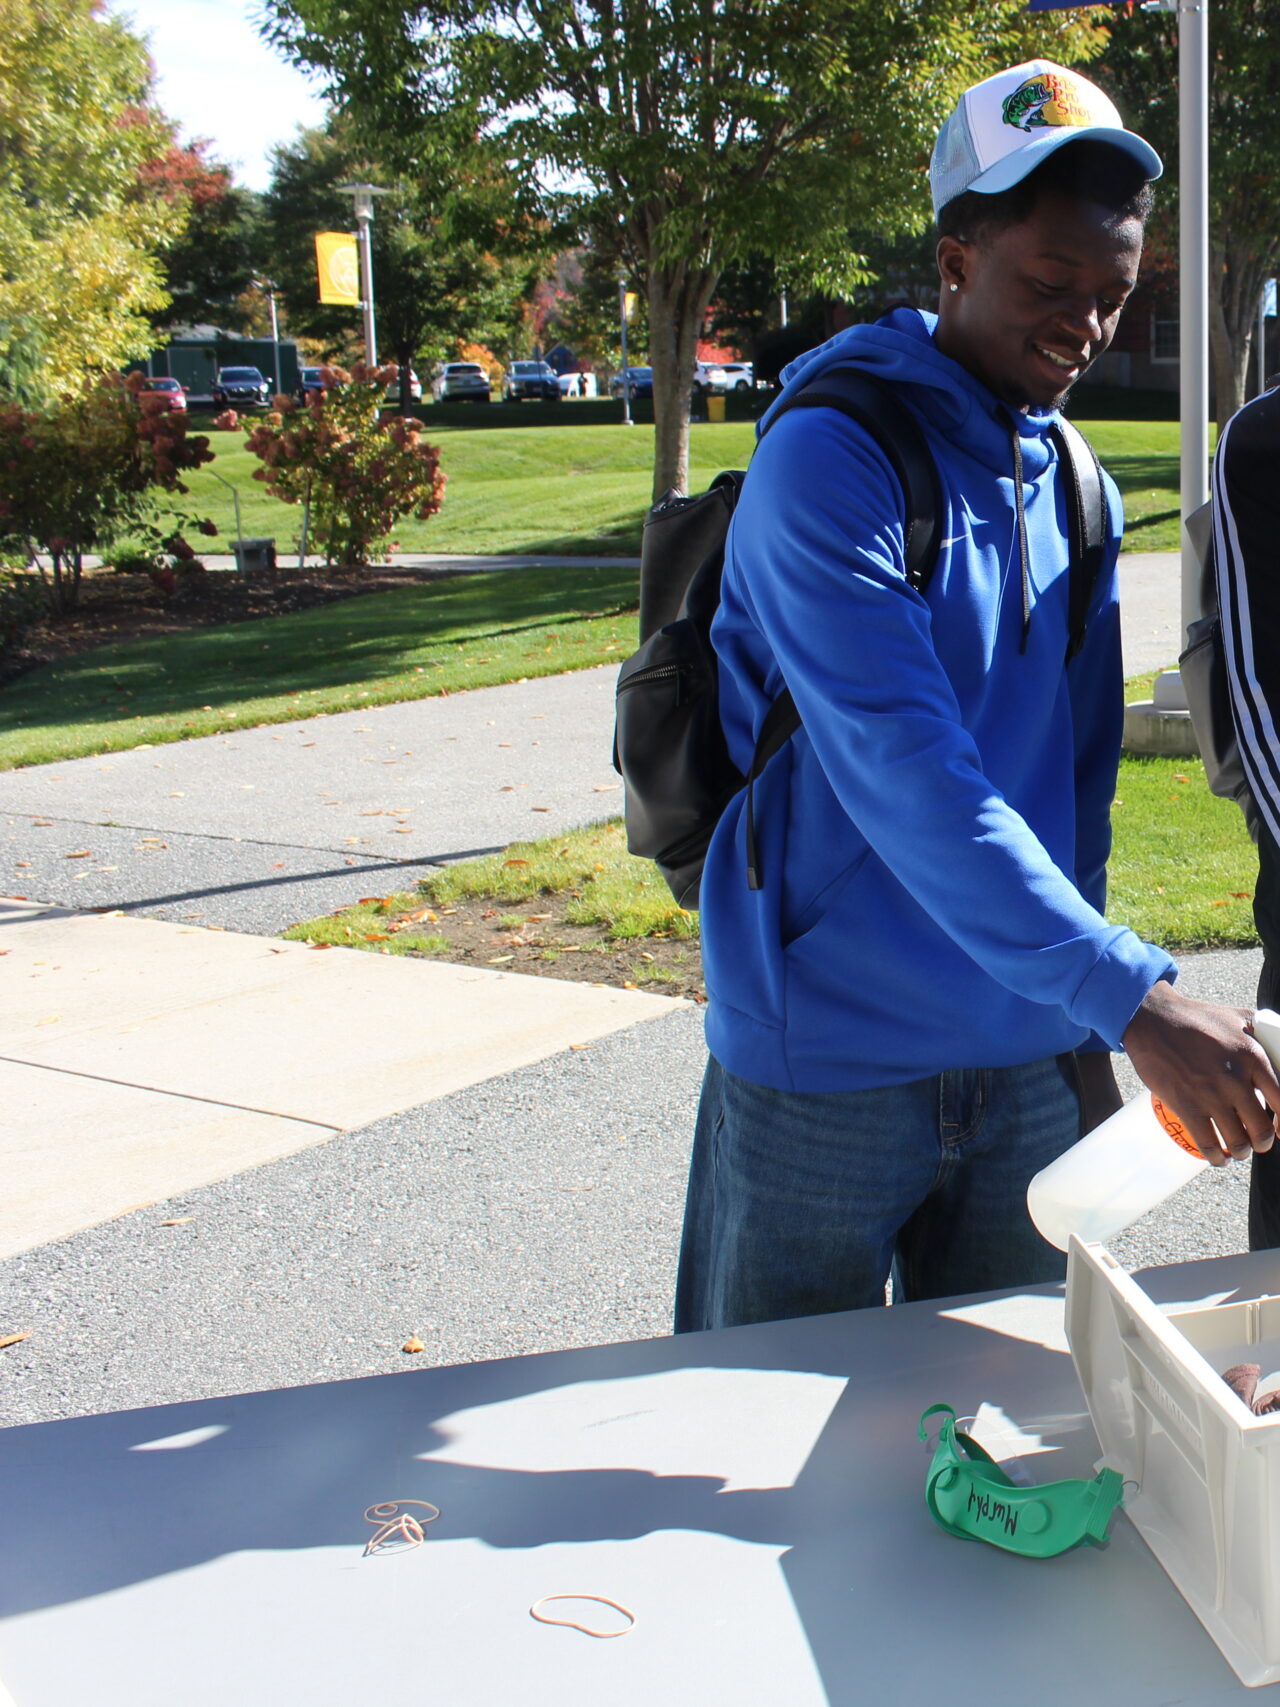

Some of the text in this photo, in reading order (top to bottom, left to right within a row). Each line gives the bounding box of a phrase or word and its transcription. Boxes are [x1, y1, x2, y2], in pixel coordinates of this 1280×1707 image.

[1046, 73, 1077, 90] Bas
[1053, 86, 1080, 103] Pro
[1057, 100, 1095, 121] Shop
[967, 1481, 1019, 1536] Murphy
